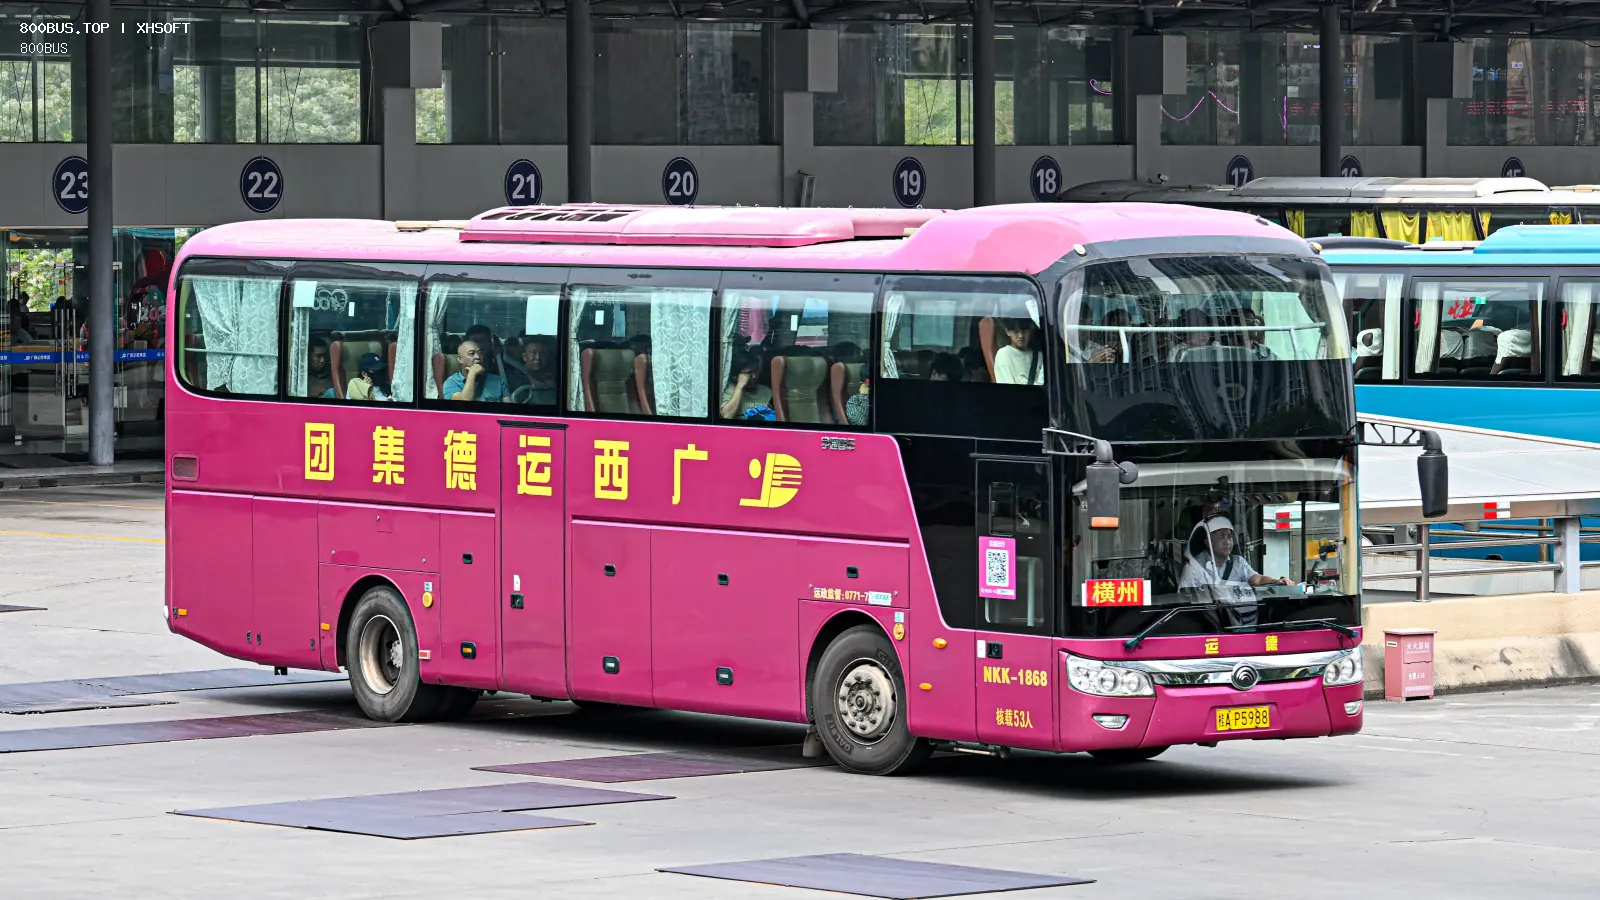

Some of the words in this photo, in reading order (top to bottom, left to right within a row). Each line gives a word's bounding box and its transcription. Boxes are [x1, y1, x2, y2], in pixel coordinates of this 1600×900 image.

[60, 171, 88, 199] 23
[247, 171, 279, 199] 22
[511, 173, 537, 199] 21
[667, 170, 695, 197] 20
[899, 169, 921, 196] 19
[1036, 168, 1057, 194] 18
[1231, 167, 1249, 188] 17
[1092, 581, 1139, 604] 横州
[983, 665, 1048, 687] NKK-1868
[995, 707, 1034, 729] 核载53人
